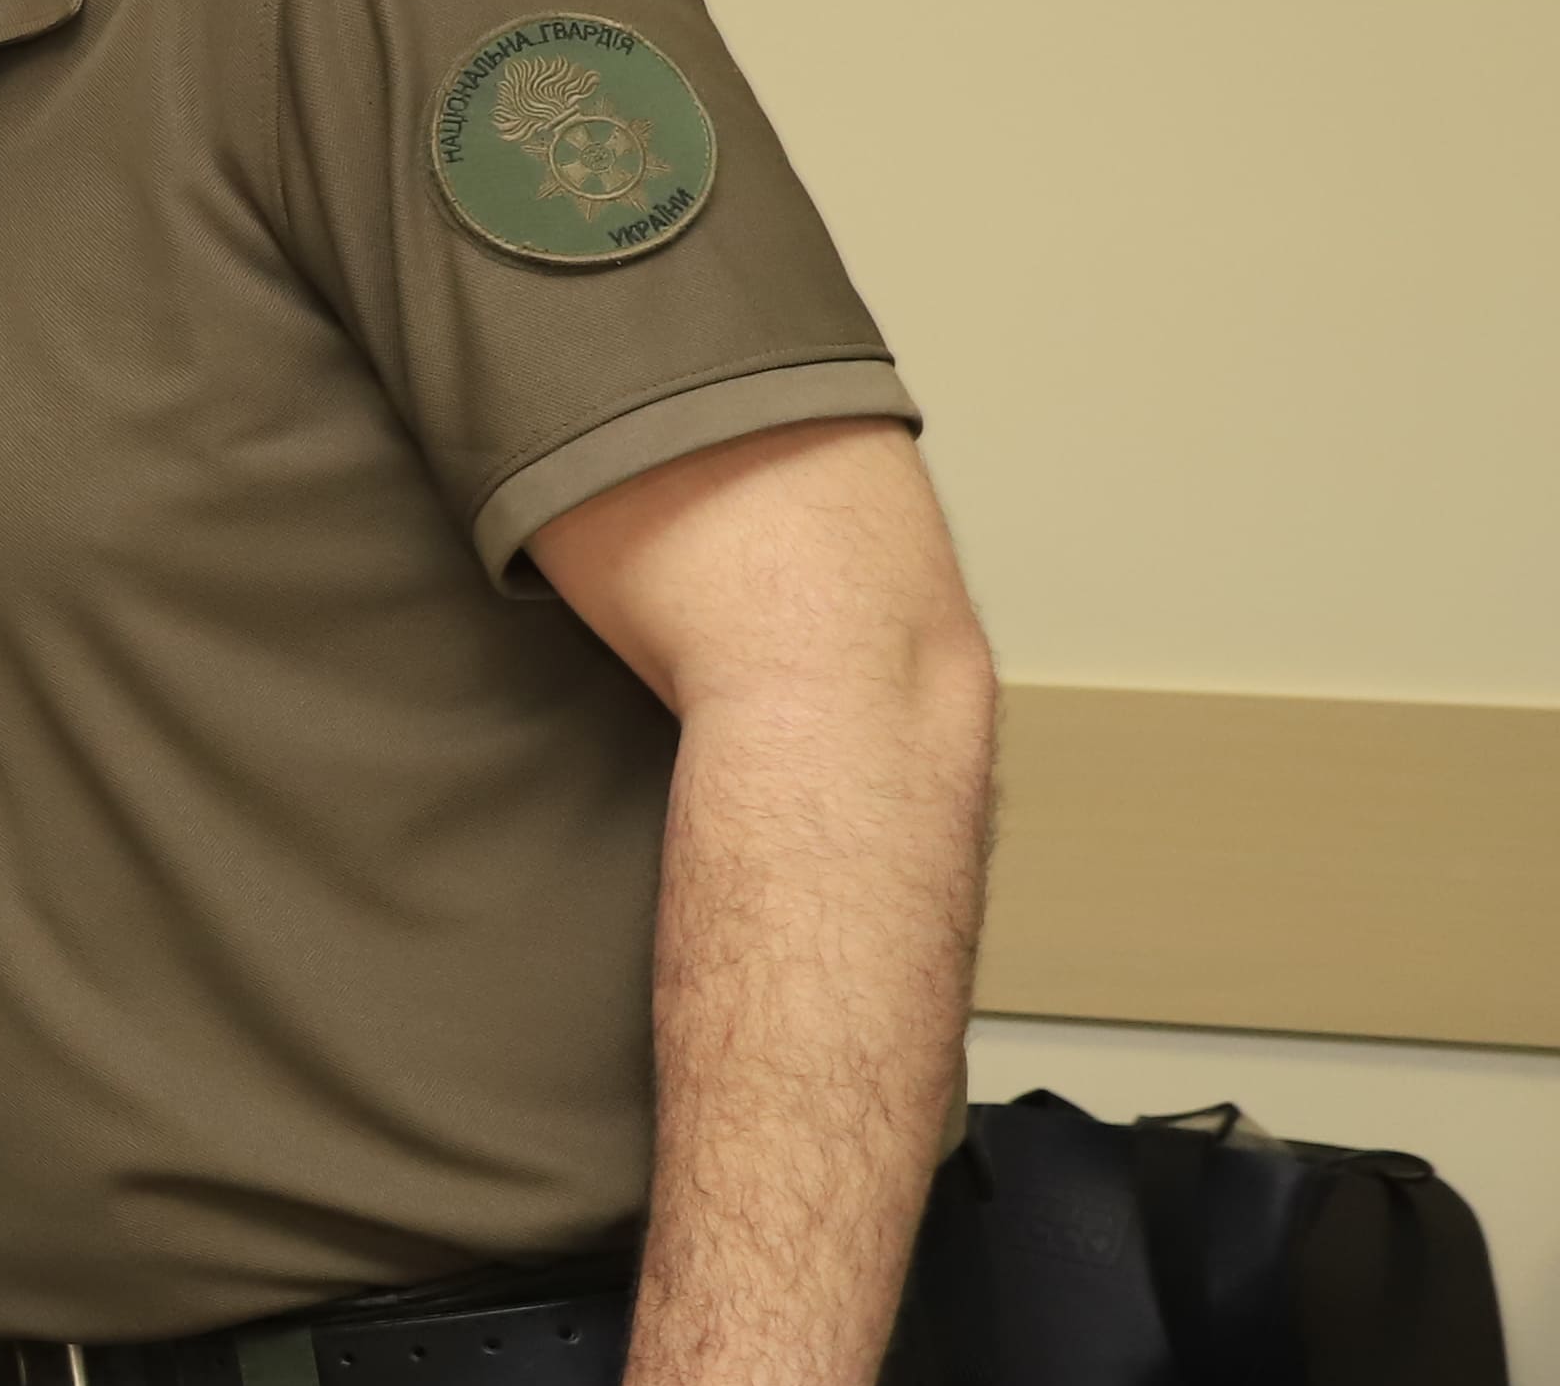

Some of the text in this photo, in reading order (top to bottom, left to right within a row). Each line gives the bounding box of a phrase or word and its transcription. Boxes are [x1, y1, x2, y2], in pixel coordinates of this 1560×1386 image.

[436, 21, 637, 166] НАЦІОНАЛЬНА ГВАРДІЯ
[606, 185, 696, 248] УКРАЇНИ
